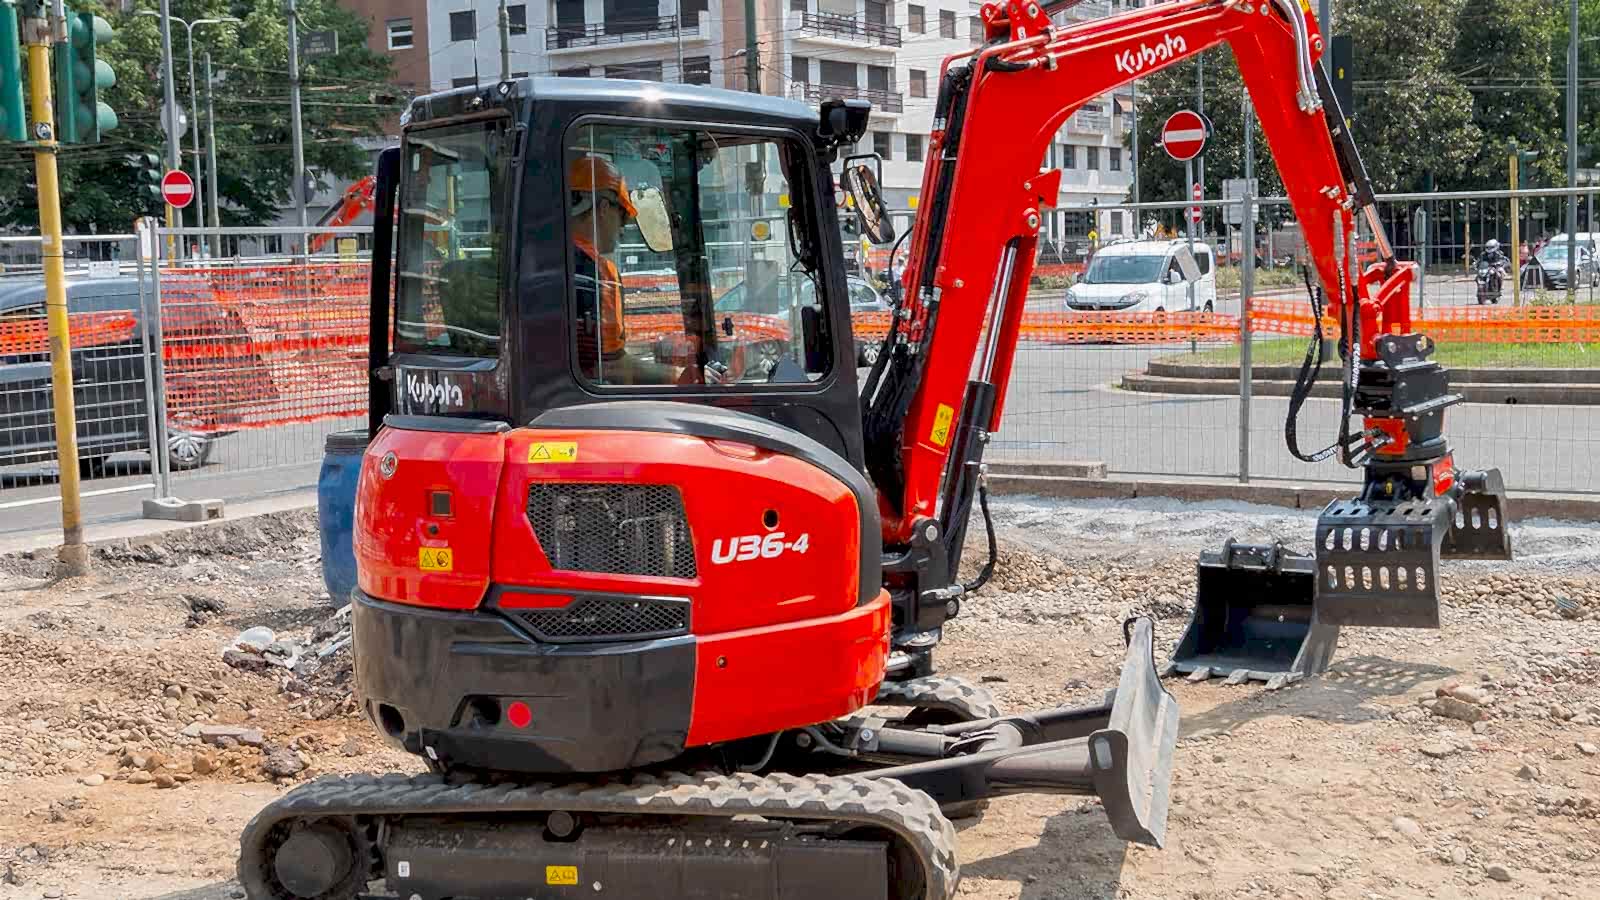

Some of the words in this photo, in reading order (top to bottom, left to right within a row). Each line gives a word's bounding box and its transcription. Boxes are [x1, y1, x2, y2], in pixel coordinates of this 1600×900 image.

[1115, 33, 1187, 74] Kubota
[407, 373, 463, 407] Kubota
[711, 532, 809, 564] U36-4
